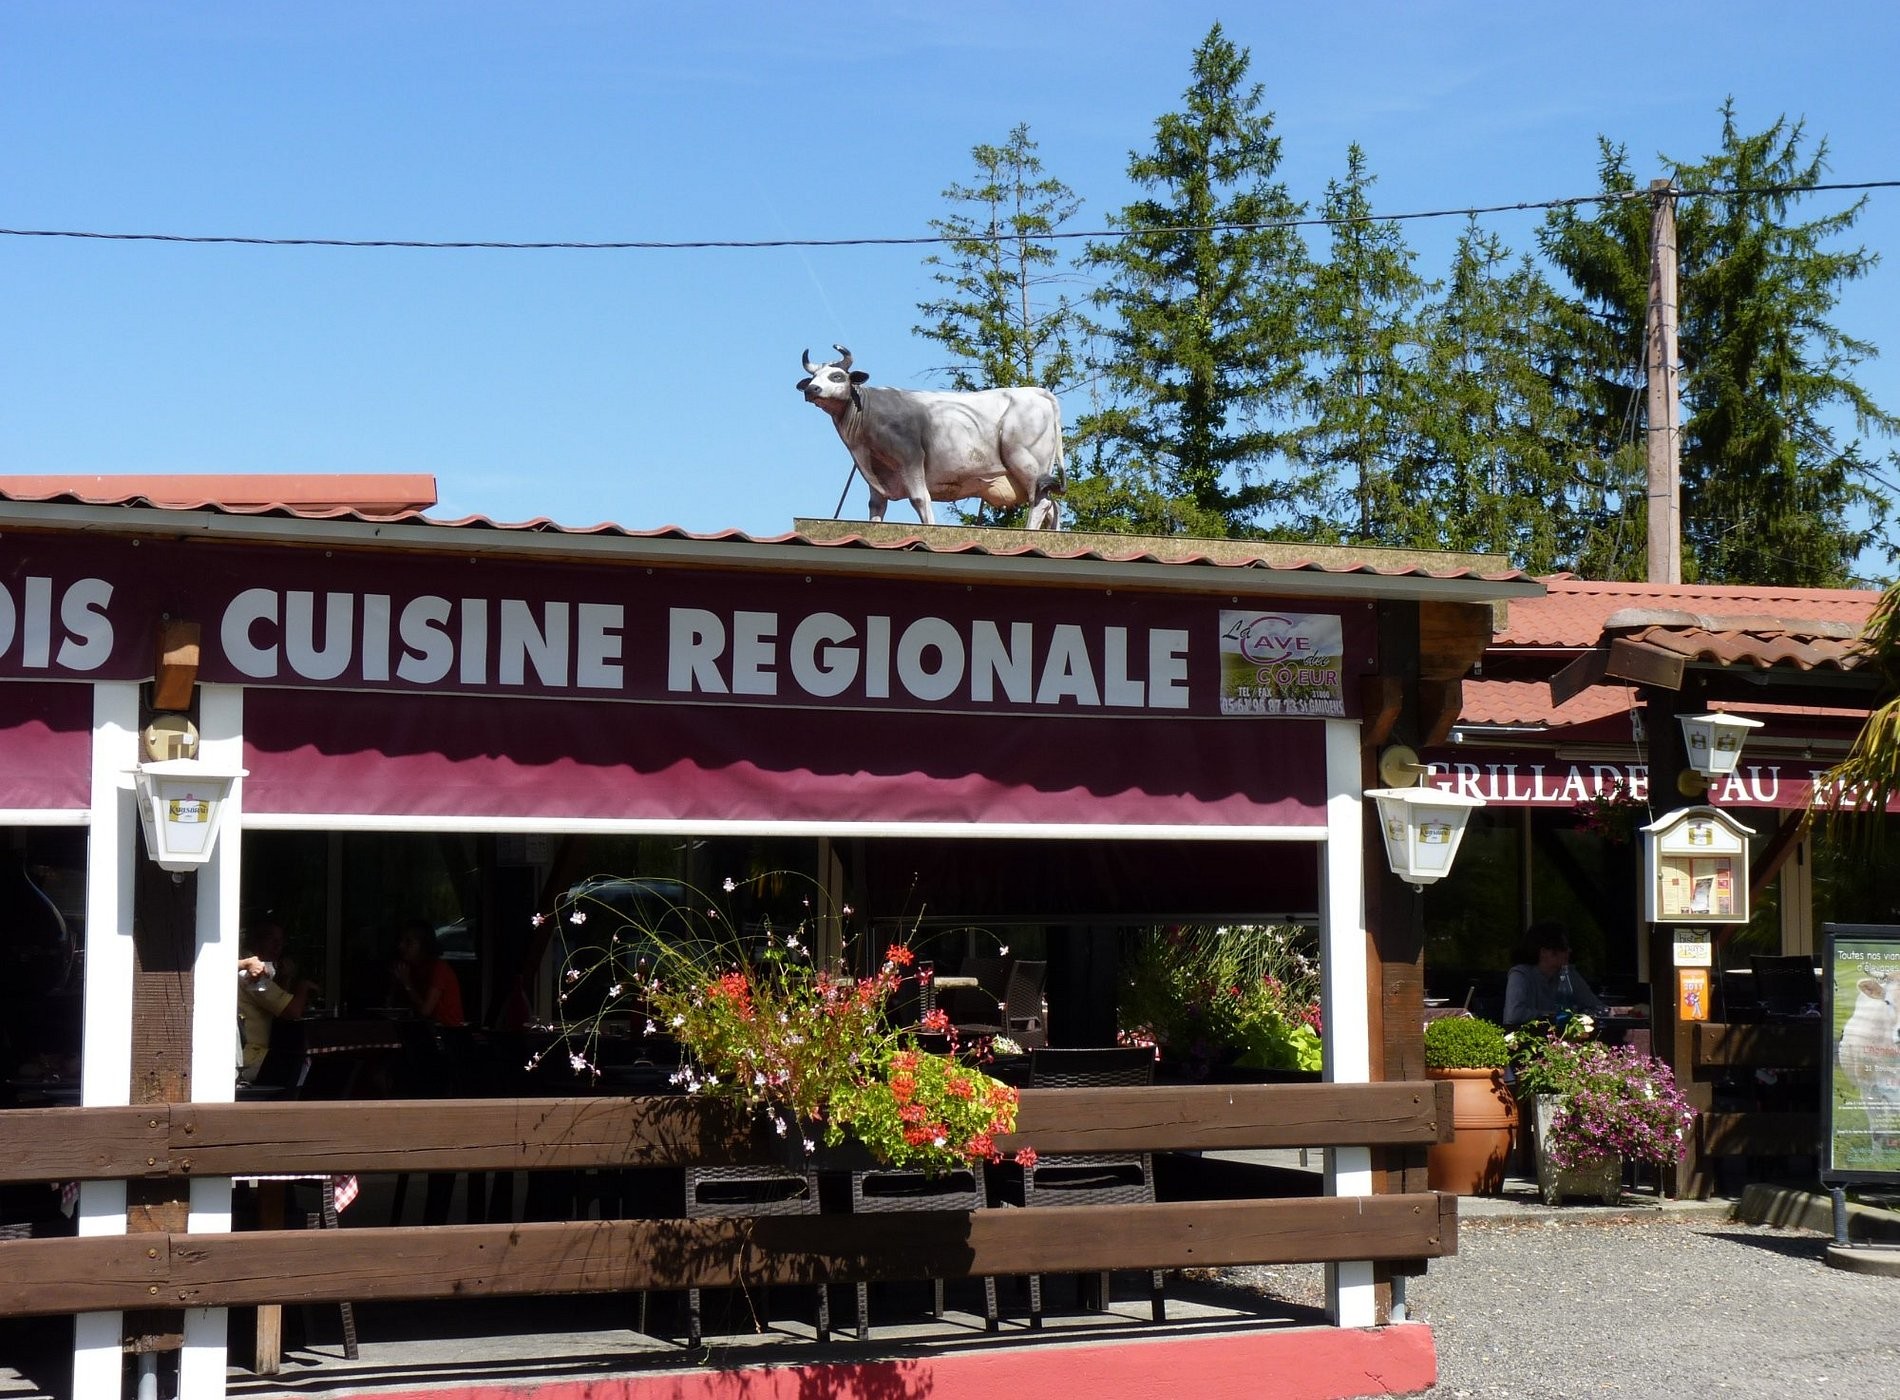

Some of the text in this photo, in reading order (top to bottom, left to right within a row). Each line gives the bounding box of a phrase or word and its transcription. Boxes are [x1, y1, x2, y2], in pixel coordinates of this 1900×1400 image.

[1222, 619, 1251, 640] La
[0, 576, 1190, 709] IS CUISINE REGIONALE
[1240, 616, 1311, 665] CAVE
[1302, 650, 1330, 667] du
[1257, 668, 1338, 686] COEUR
[1838, 950, 1864, 960] Toutes
[1867, 952, 1881, 960] nos
